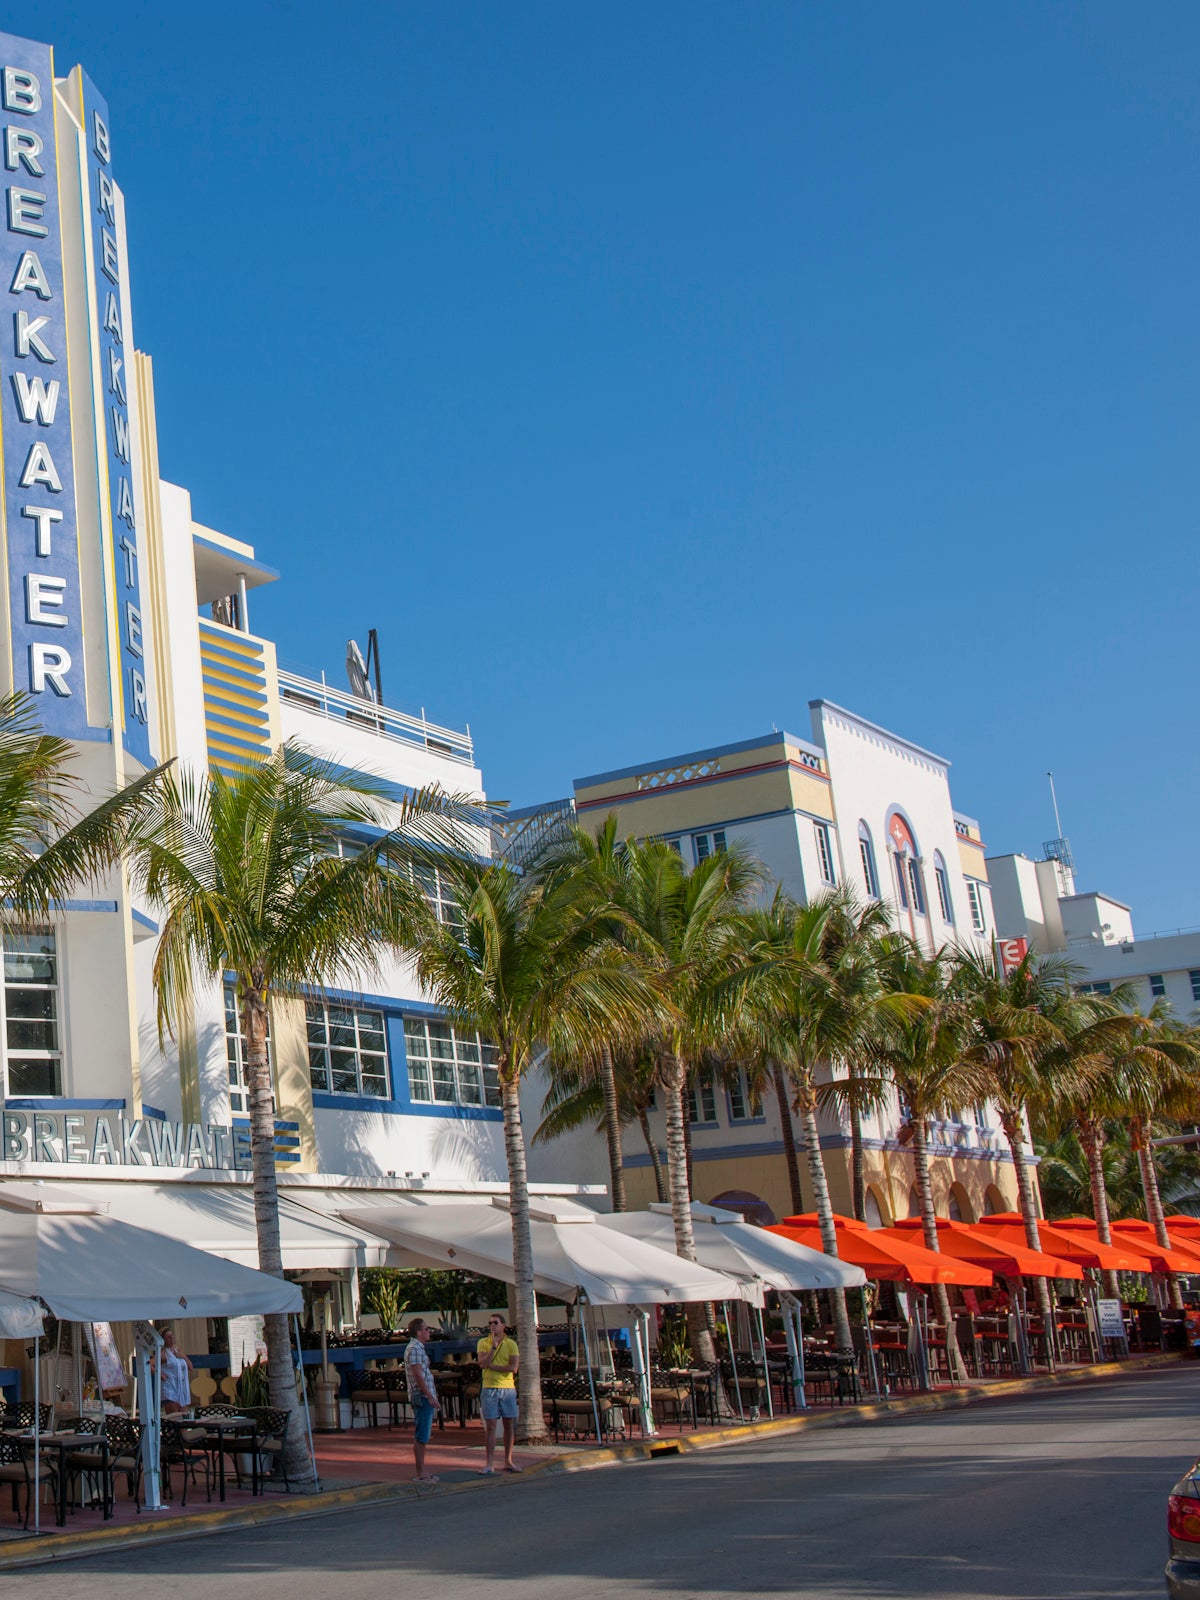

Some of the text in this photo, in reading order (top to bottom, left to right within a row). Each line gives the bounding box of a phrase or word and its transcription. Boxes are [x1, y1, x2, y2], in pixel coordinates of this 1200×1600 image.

[3, 66, 72, 697] BREAKWATER
[93, 110, 148, 725] BREAKWATER
[3, 1111, 254, 1171] BREAKWATE
